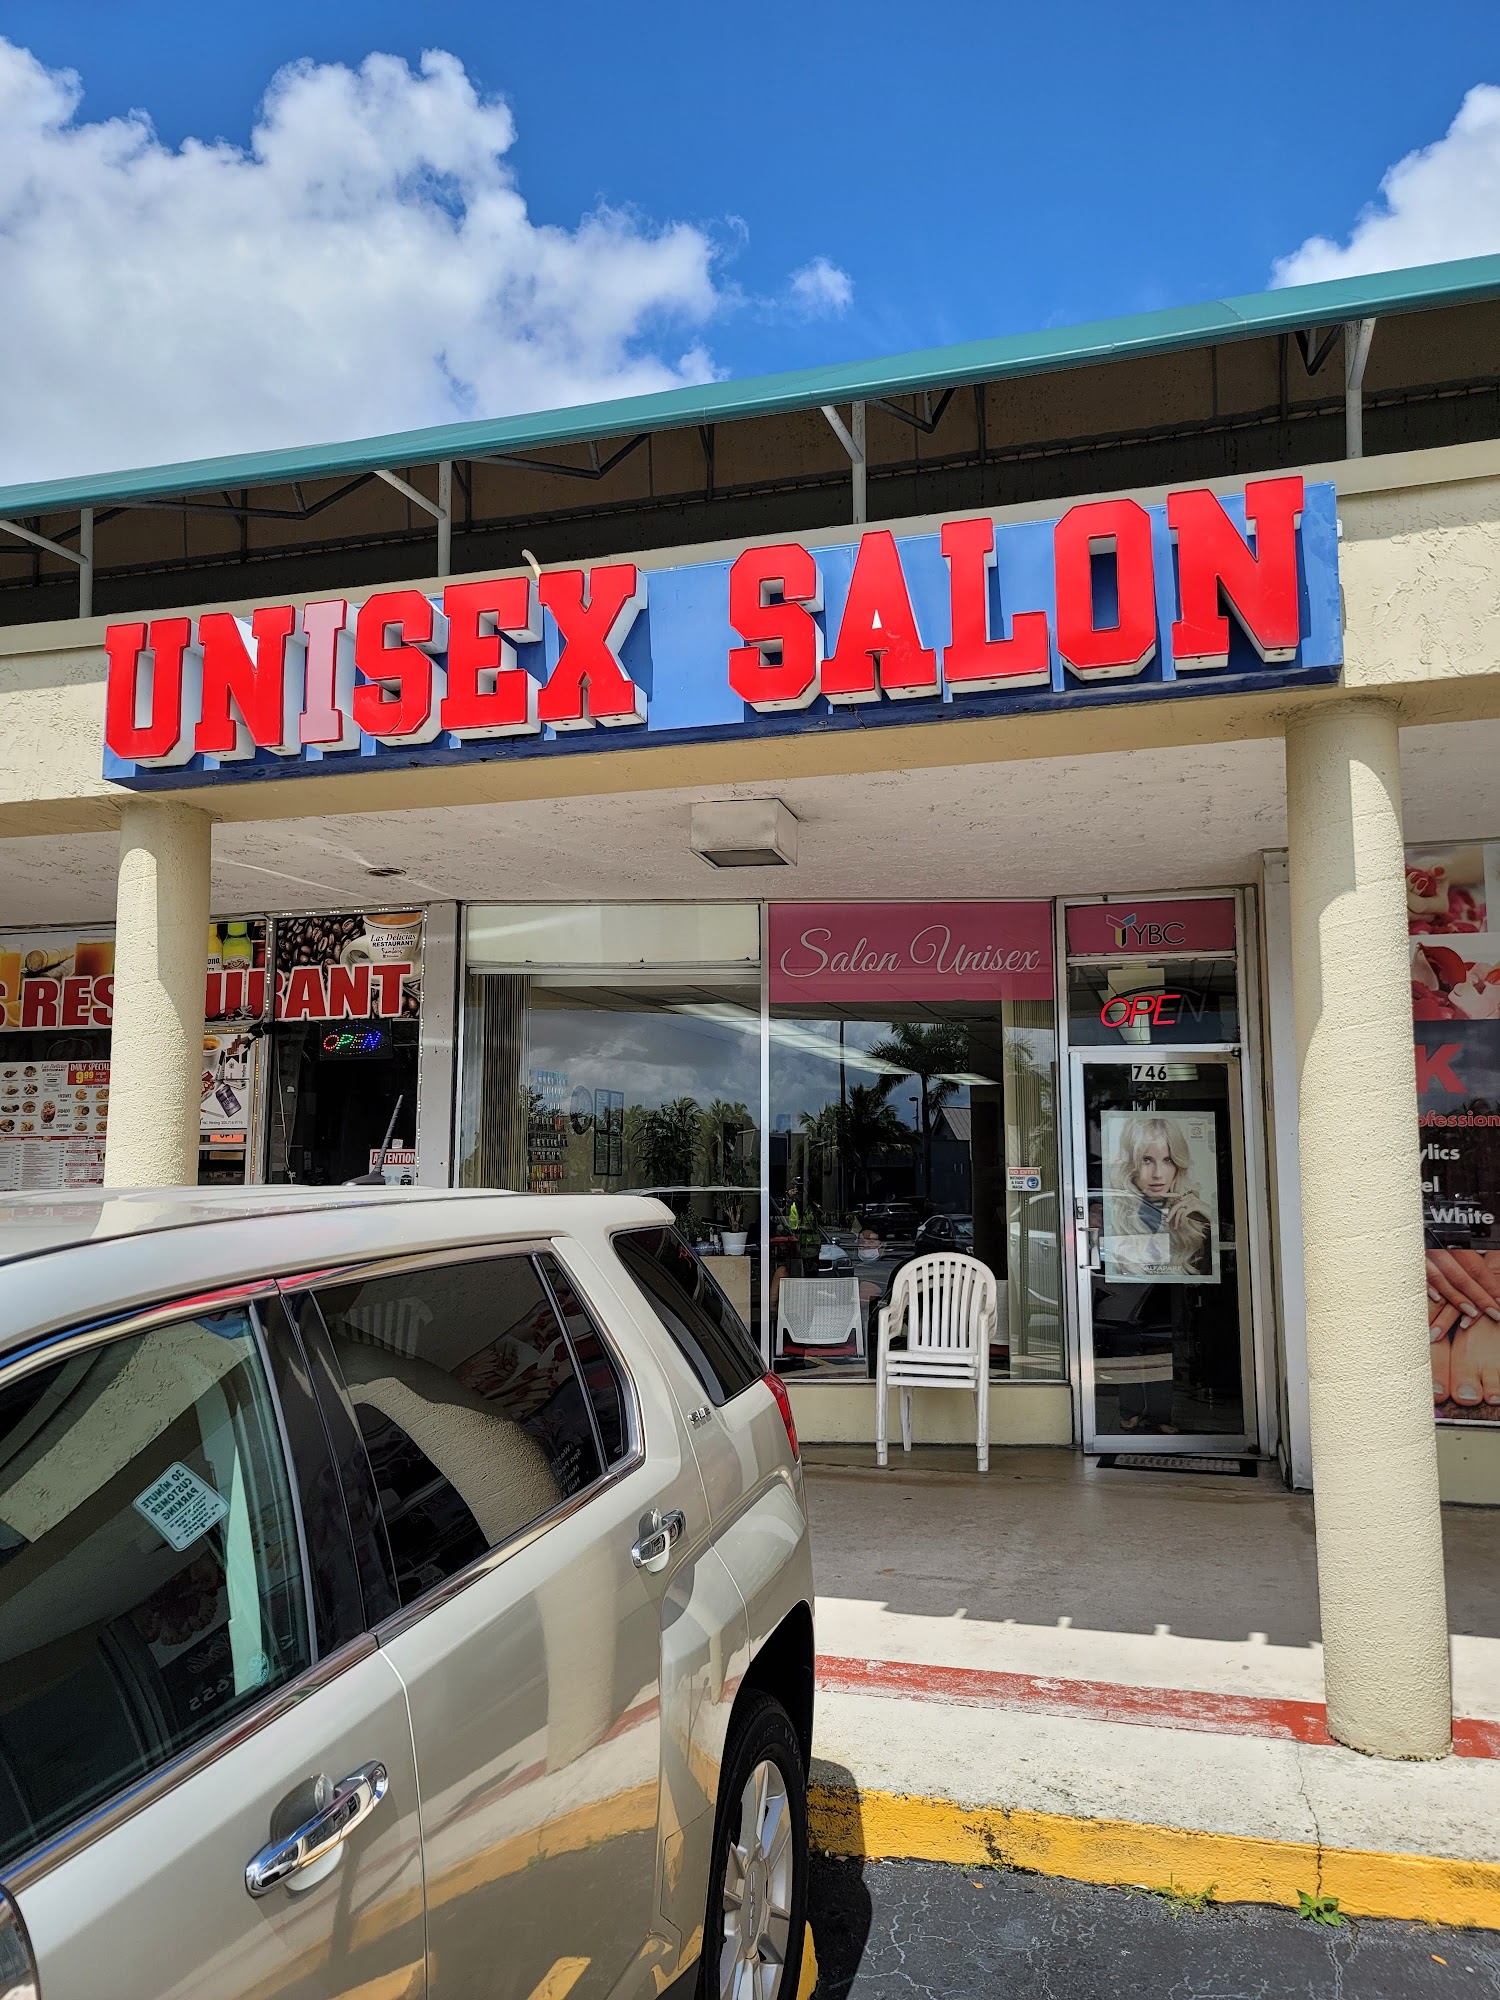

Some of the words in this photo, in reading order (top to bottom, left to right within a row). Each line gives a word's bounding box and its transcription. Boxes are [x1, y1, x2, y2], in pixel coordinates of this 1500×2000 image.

[104, 563, 647, 767] UNISEX
[728, 476, 1304, 711] SALON
[370, 934, 384, 942] Las
[386, 932, 416, 941] Delicias
[780, 927, 901, 978] Salon
[909, 924, 1041, 976] Unisex
[1100, 993, 1206, 1028] OPEN
[323, 1031, 382, 1050] OPEN
[70, 1063, 87, 1071] DAILY
[1133, 1065, 1167, 1080] 746
[1431, 1207, 1495, 1225] White
